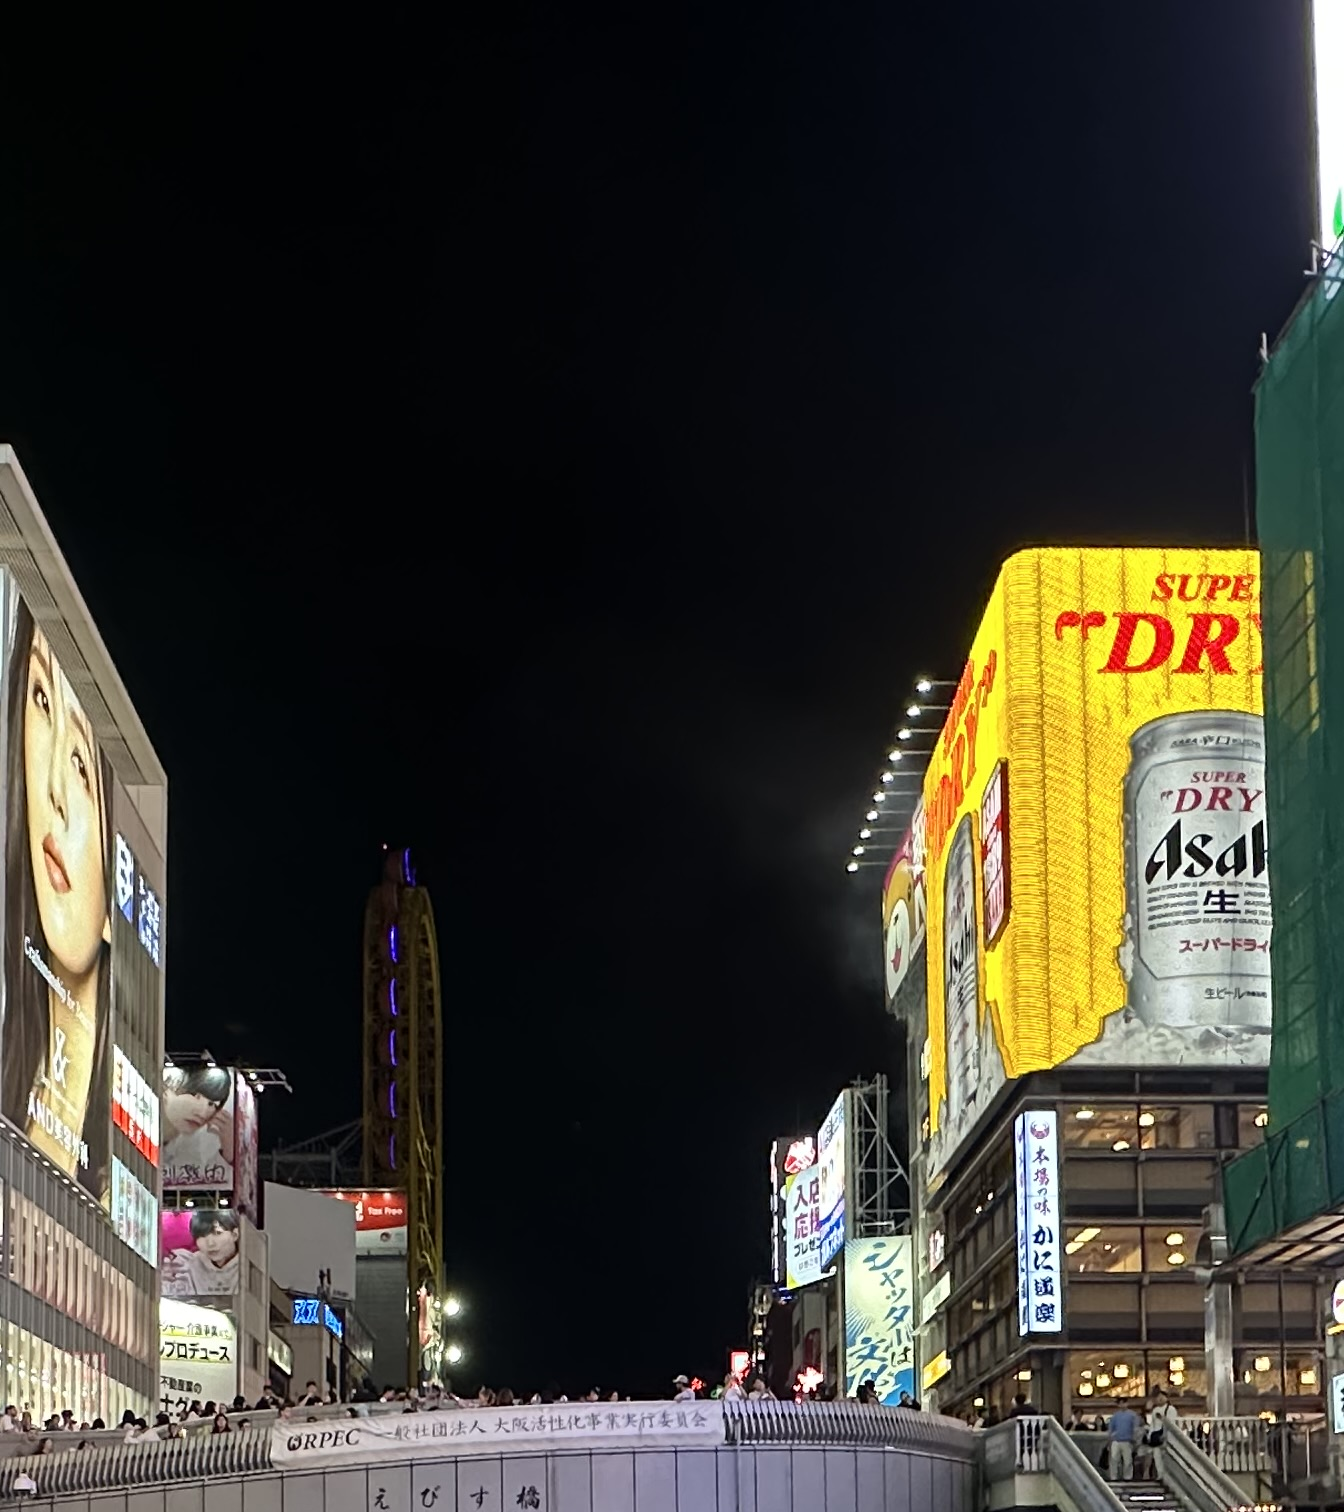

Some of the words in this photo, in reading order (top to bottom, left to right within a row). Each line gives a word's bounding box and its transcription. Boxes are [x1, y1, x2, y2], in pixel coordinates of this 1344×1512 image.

[1151, 572, 1261, 603] SUPE
[1190, 770, 1247, 784] SUPER
[1203, 889, 1241, 914] 生
[1178, 938, 1269, 954] スーパードライ
[1031, 1145, 1052, 1216] 本場の味
[373, 1484, 542, 1512] えびす橋
